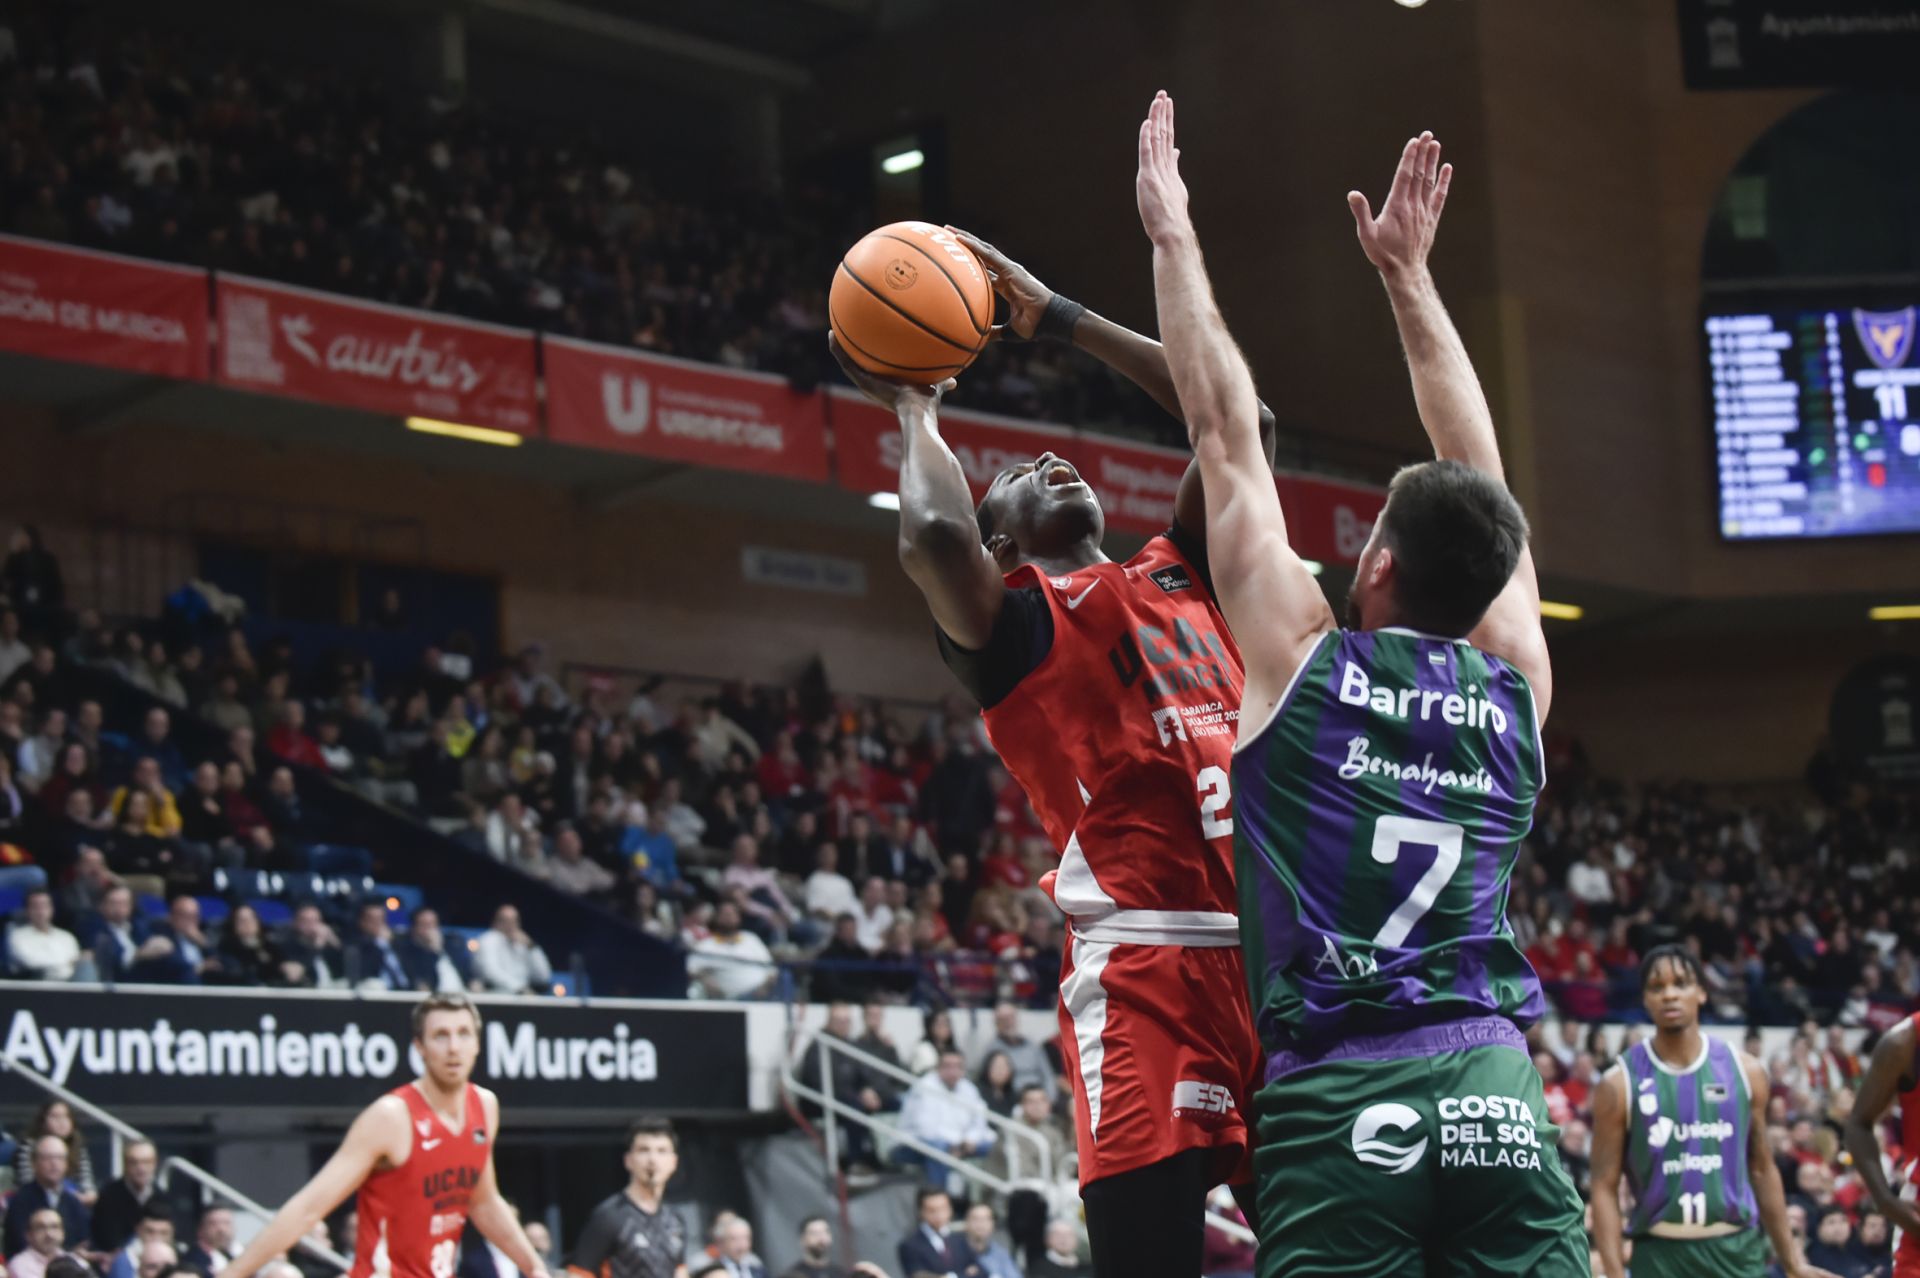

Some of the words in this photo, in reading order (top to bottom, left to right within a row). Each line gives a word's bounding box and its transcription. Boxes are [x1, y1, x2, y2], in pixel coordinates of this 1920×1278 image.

[1338, 660, 1508, 734] Barreiro
[1203, 712, 1223, 725] CRUZ
[1371, 814, 1464, 948] 7
[2, 1009, 399, 1087] Ayuntamiento
[487, 1022, 658, 1083] Murcia
[1438, 1095, 1536, 1127] COSTA
[1440, 1122, 1493, 1145] DEL
[1496, 1122, 1542, 1149] SOL
[1440, 1143, 1542, 1172] MÁLAGA
[1677, 1191, 1707, 1227] 11
